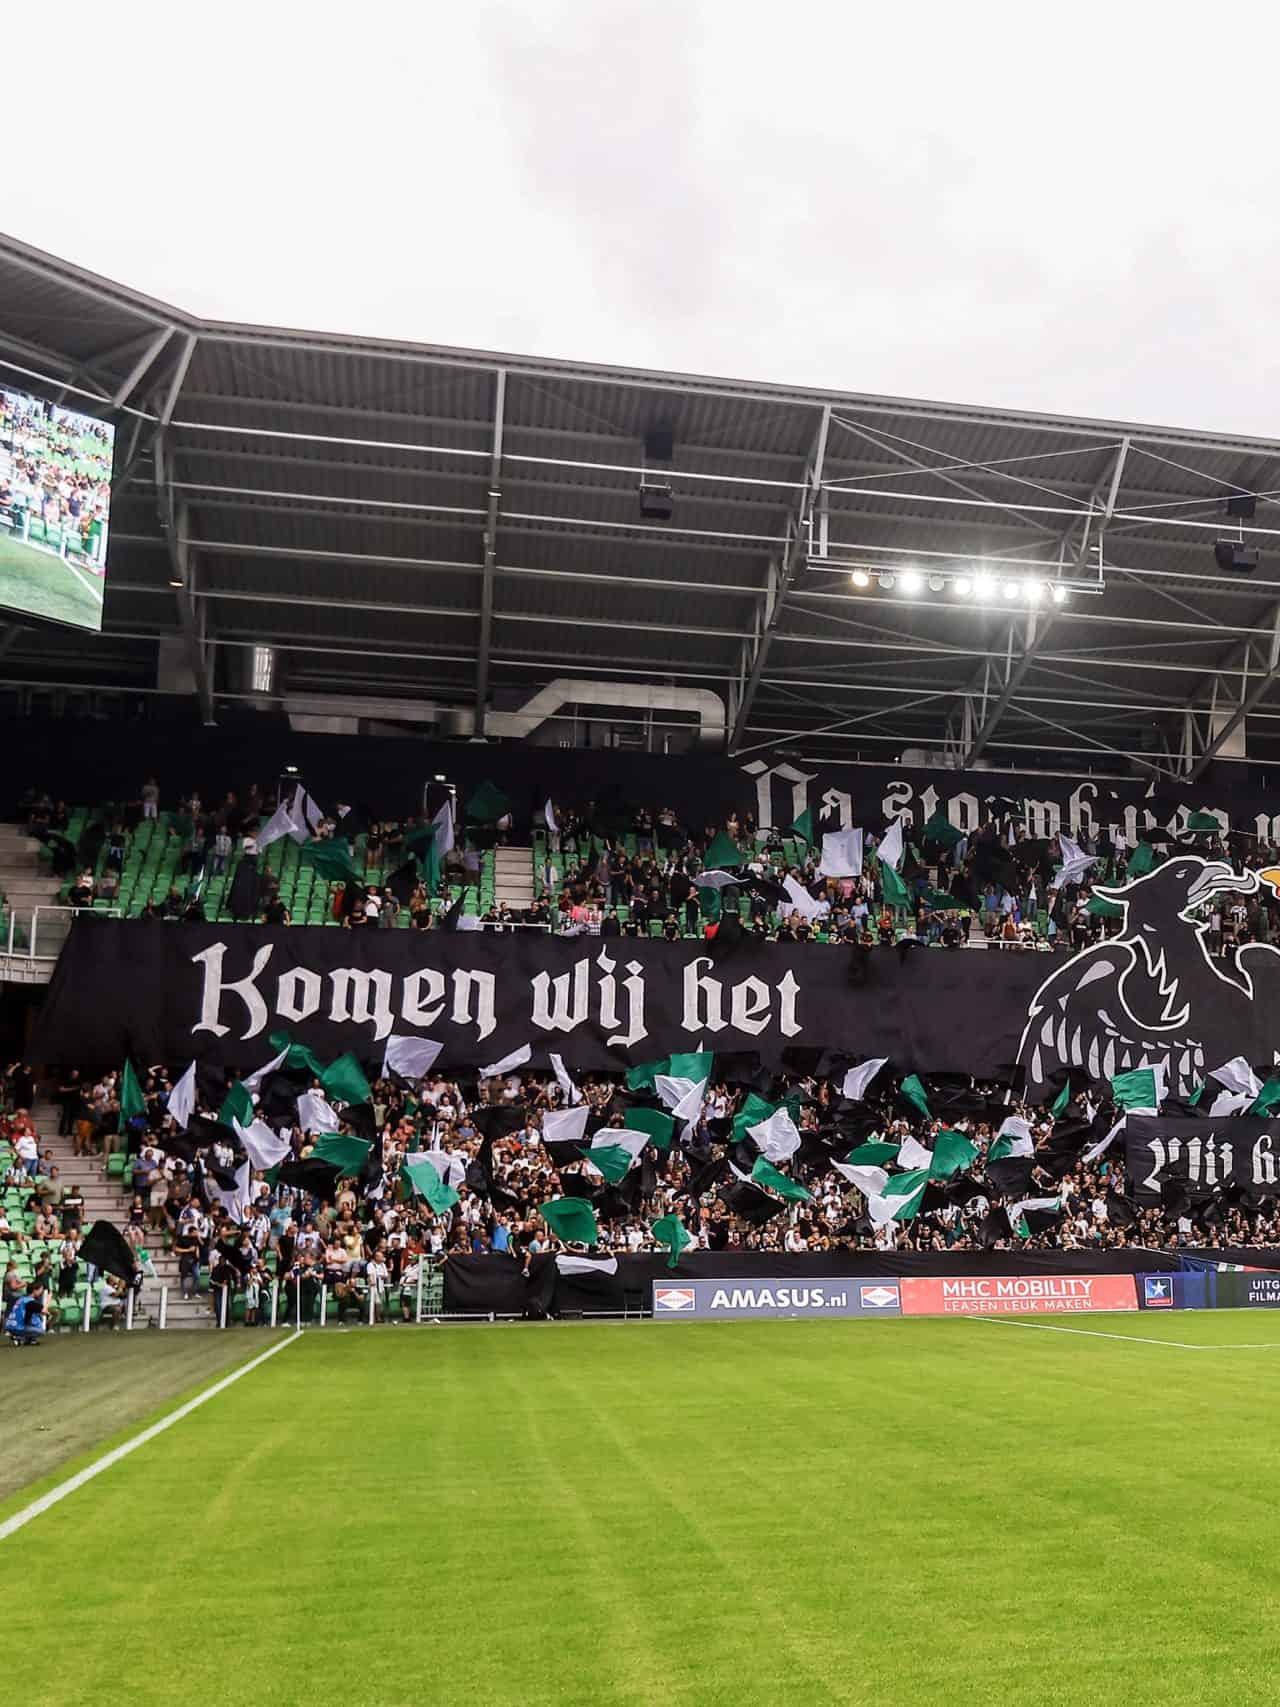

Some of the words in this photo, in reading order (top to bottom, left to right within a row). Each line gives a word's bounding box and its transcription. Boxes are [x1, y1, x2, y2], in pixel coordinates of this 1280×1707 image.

[191, 942, 497, 1042] Komen
[530, 944, 649, 1049] wij
[679, 956, 803, 1038] het
[943, 1280, 991, 1297] MHC
[997, 1278, 1093, 1297] MOBILITY
[711, 1288, 847, 1309] AMASUS.nl
[944, 1301, 998, 1312] LEASEN
[1004, 1300, 1039, 1311] LEUK
[1045, 1298, 1093, 1310] MAKEN
